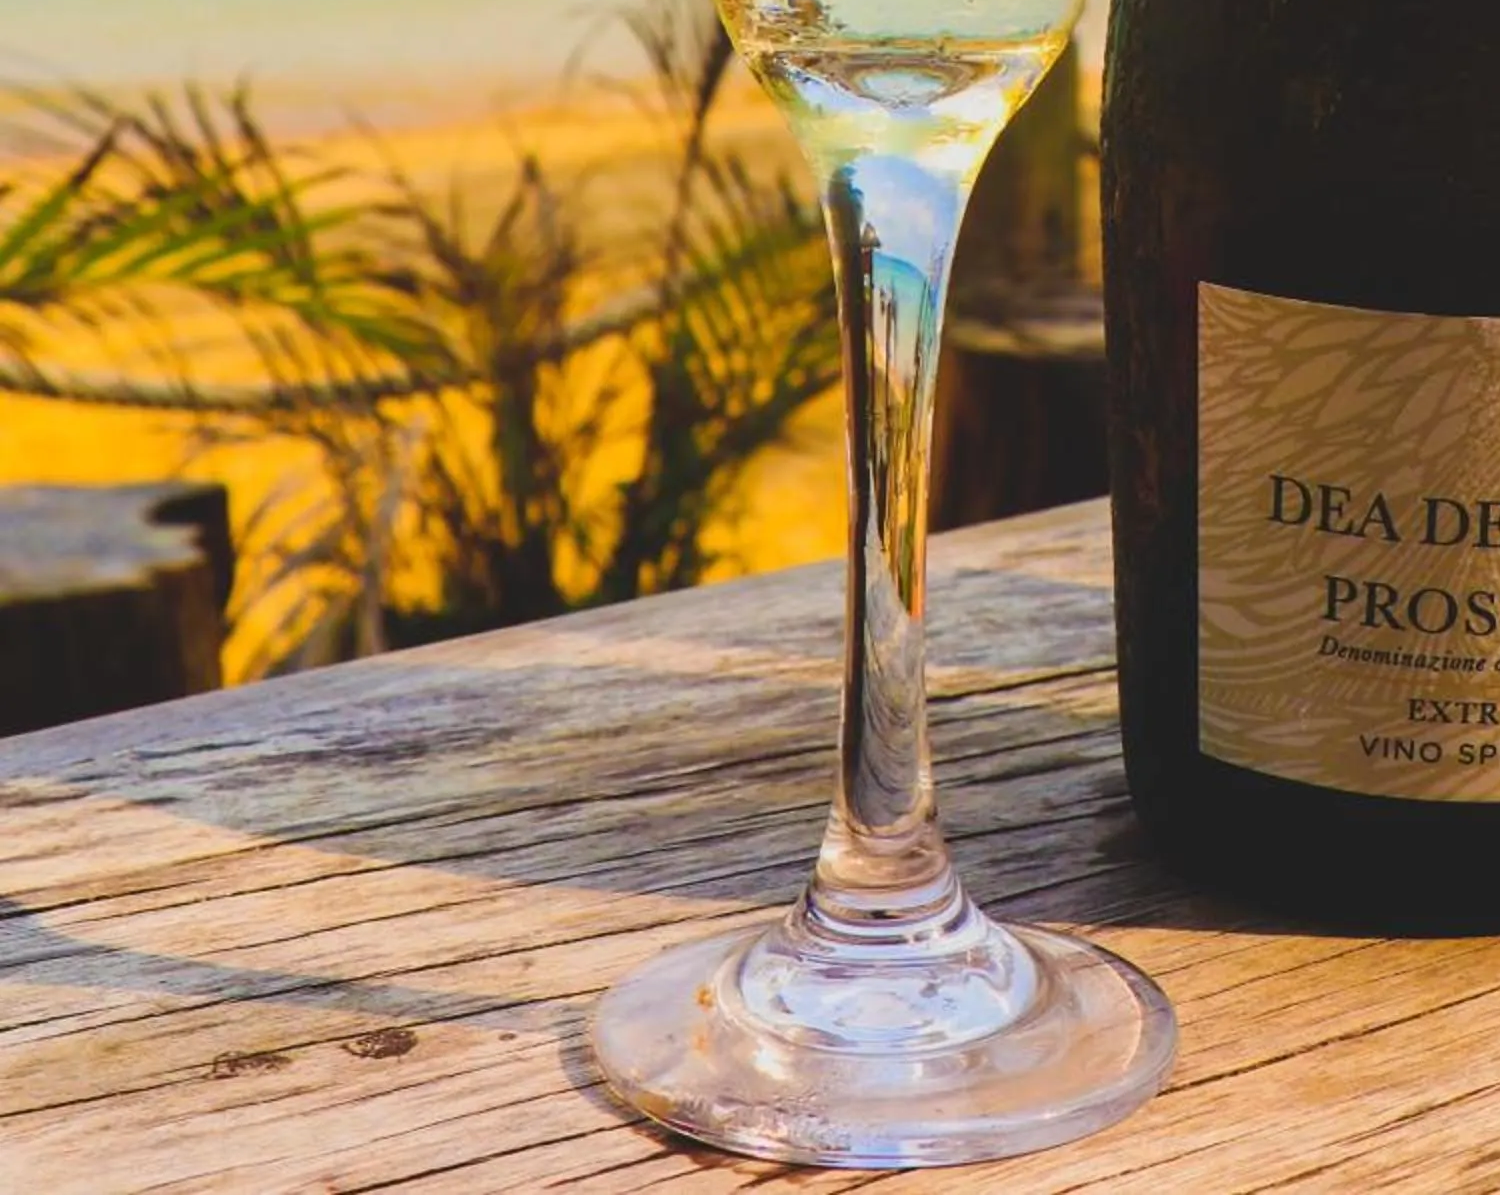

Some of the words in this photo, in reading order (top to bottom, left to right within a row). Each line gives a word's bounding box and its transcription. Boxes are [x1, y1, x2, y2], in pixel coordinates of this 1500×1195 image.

[1268, 474, 1399, 545] DEA
[1318, 634, 1486, 674] Denominazione
[1359, 734, 1443, 765] VINO
